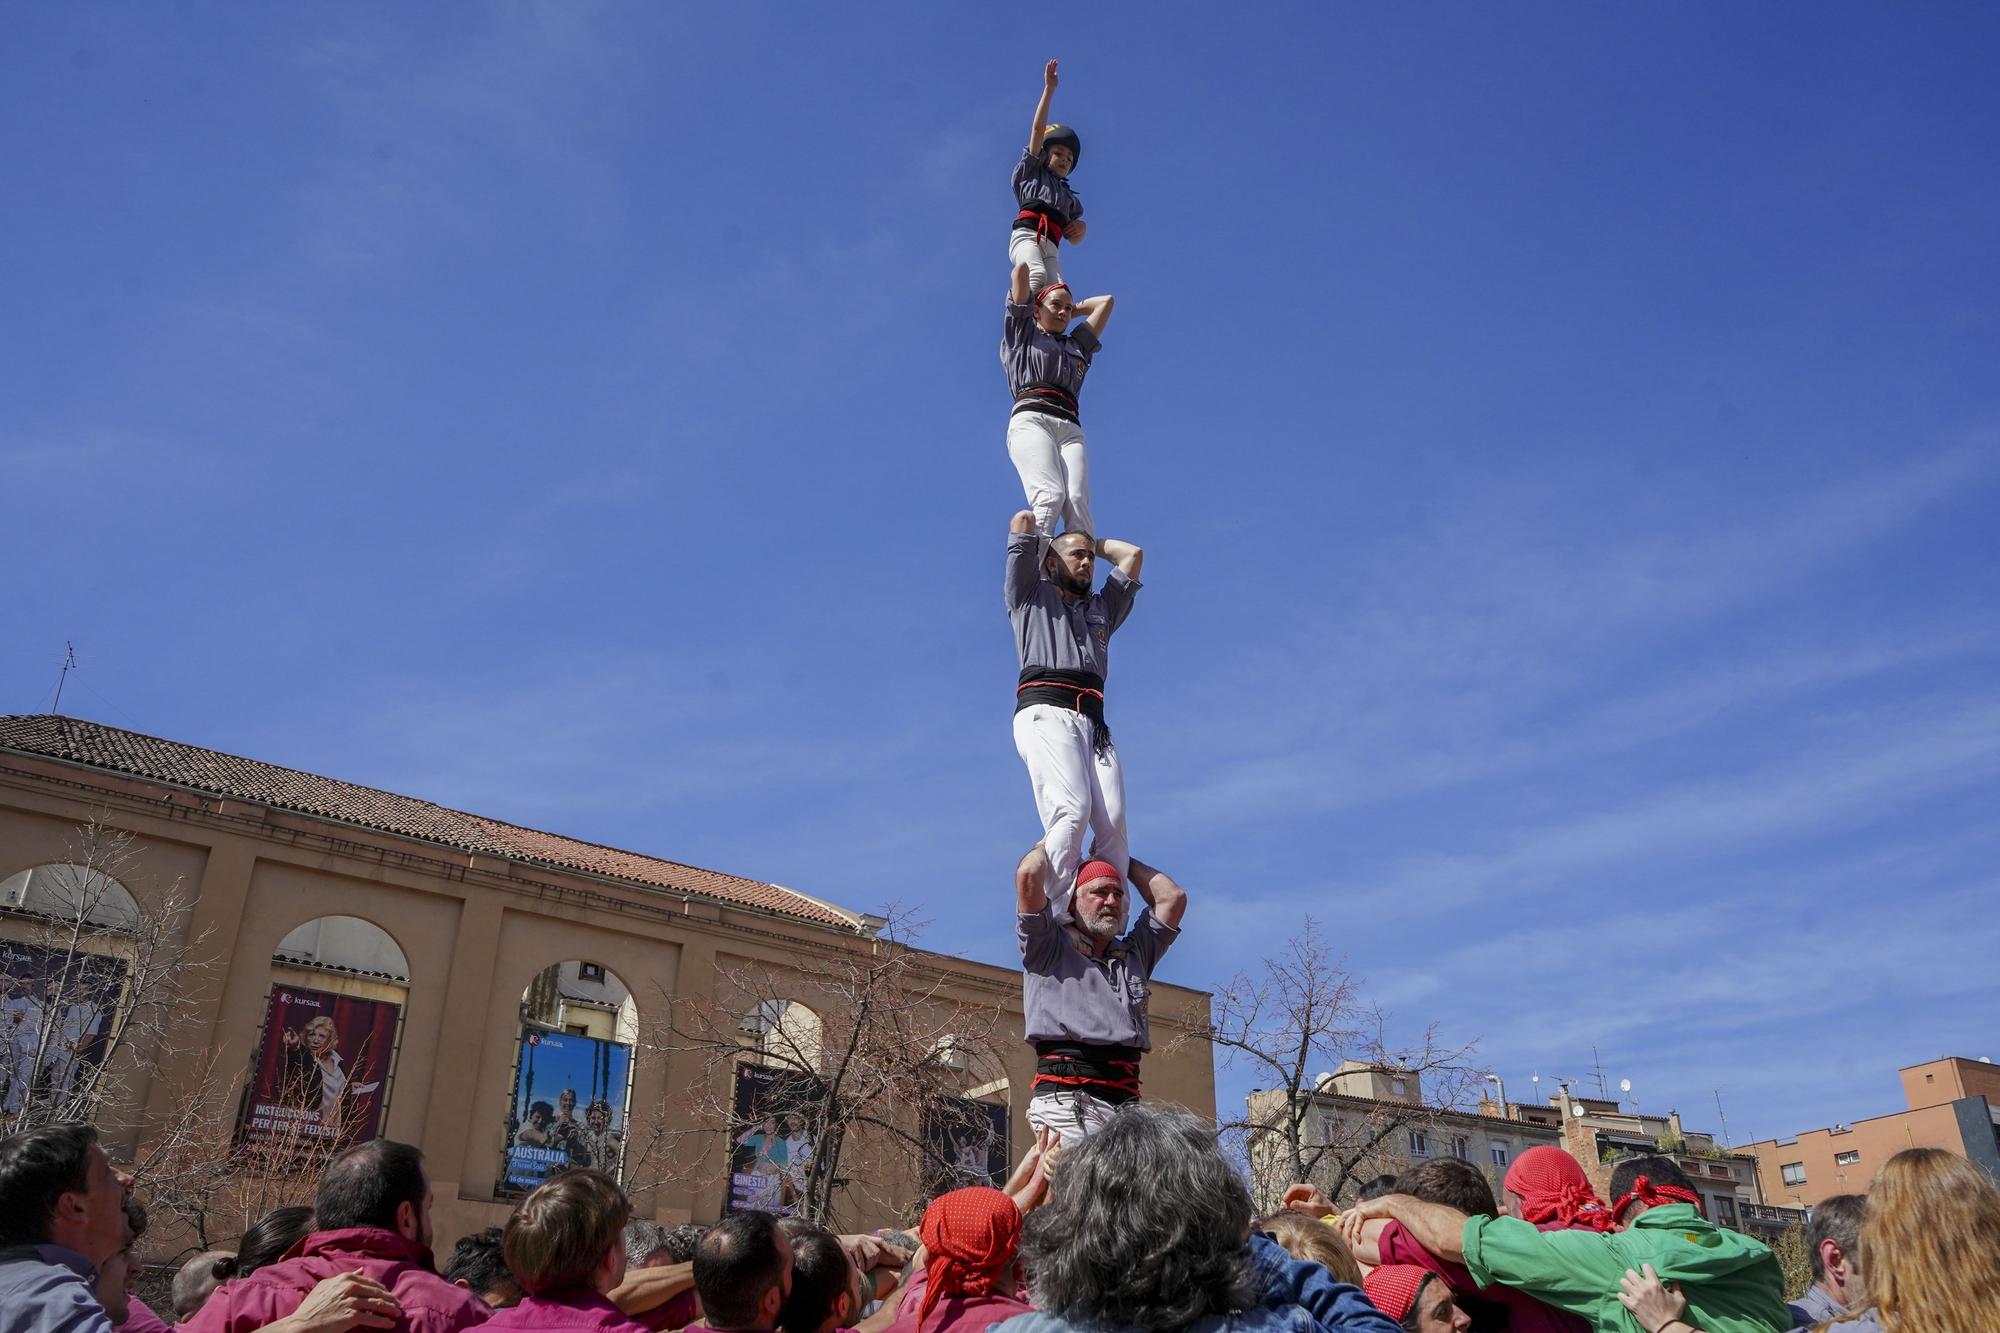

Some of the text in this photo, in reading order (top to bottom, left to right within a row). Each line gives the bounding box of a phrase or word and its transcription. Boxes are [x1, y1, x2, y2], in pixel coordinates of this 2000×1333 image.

[255, 1104, 321, 1121] INSTRUCCONS
[252, 1118, 271, 1130] PER
[514, 1147, 565, 1163] AUSTRÀLIA
